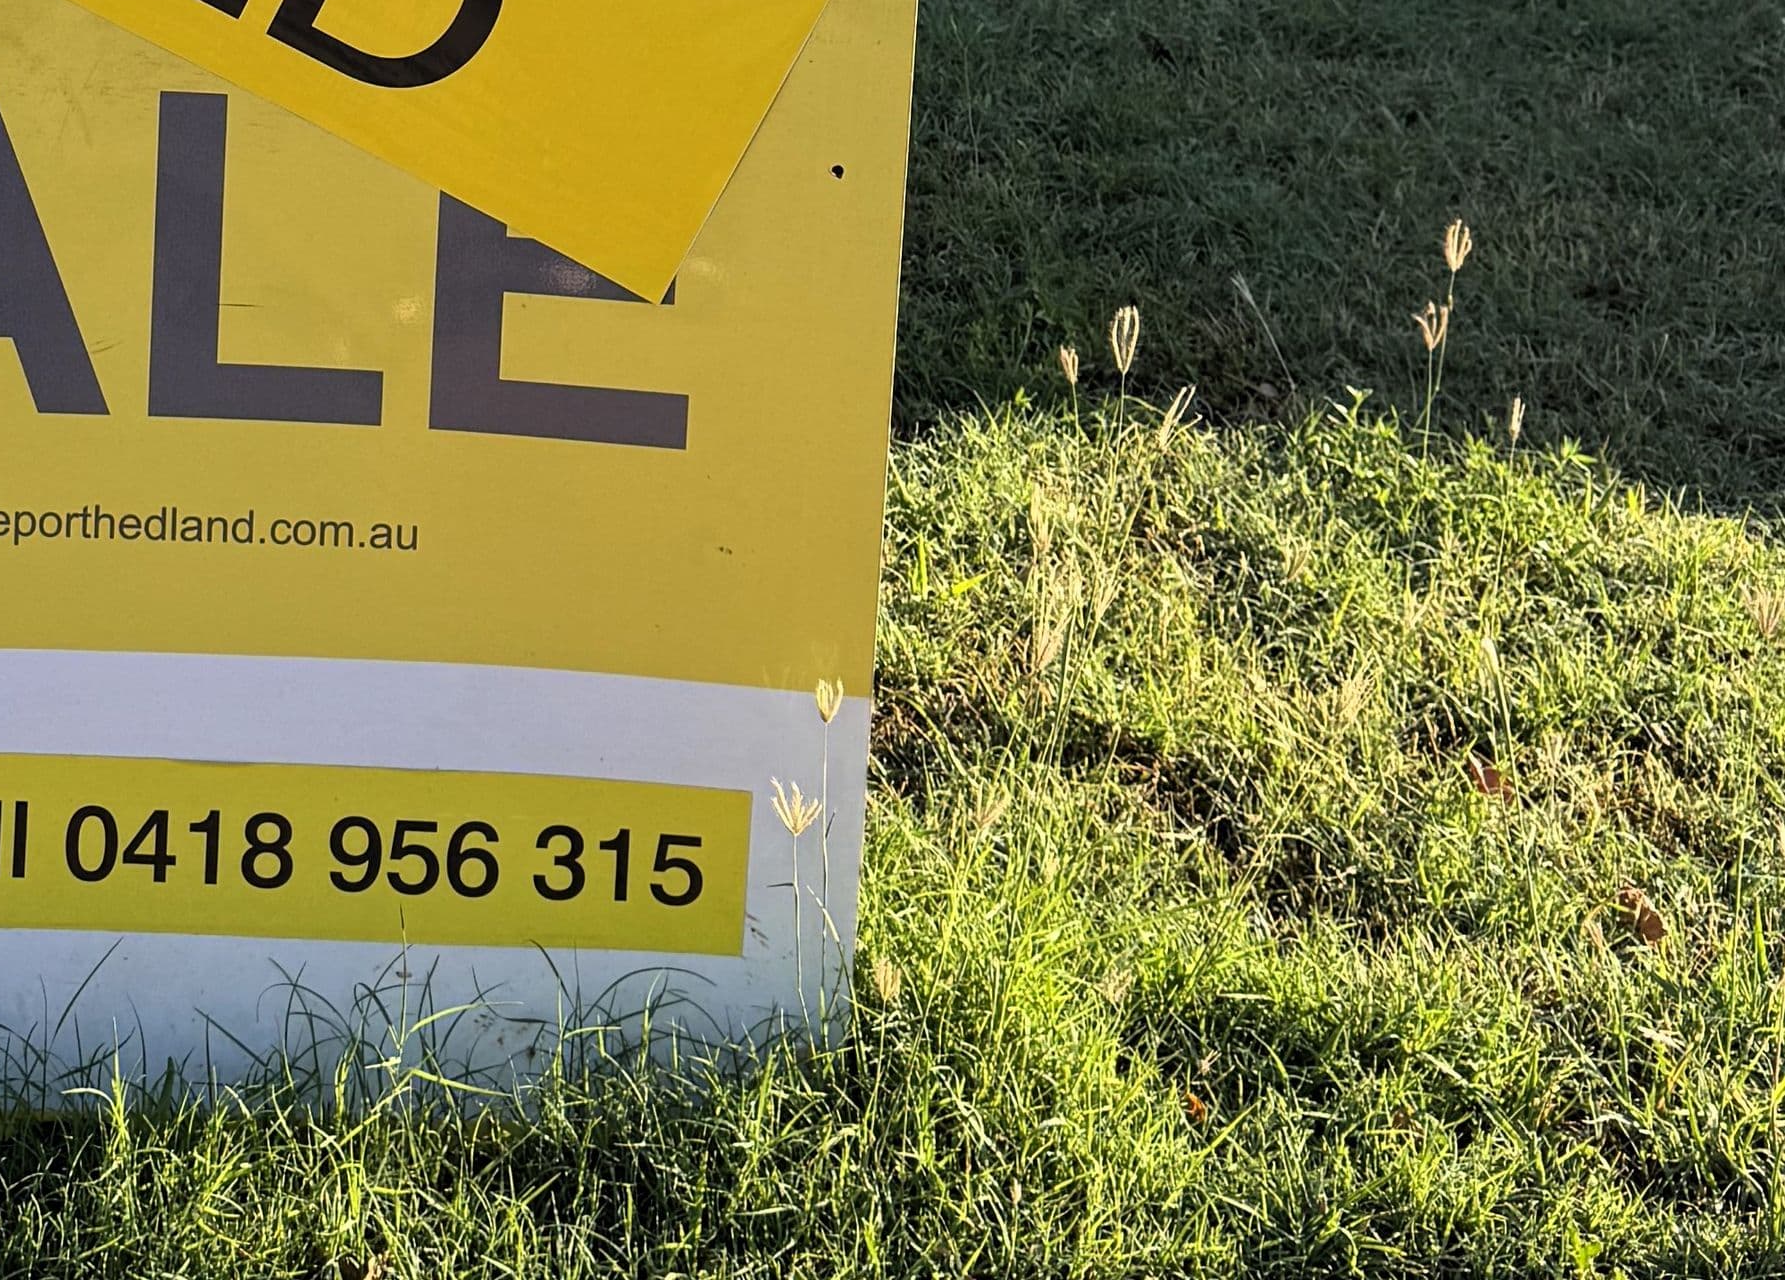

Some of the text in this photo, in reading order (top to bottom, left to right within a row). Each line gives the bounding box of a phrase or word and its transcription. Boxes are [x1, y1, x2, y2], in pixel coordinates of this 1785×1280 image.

[64, 804, 295, 891] 0418
[328, 814, 501, 899] 956
[531, 823, 705, 908] 315
